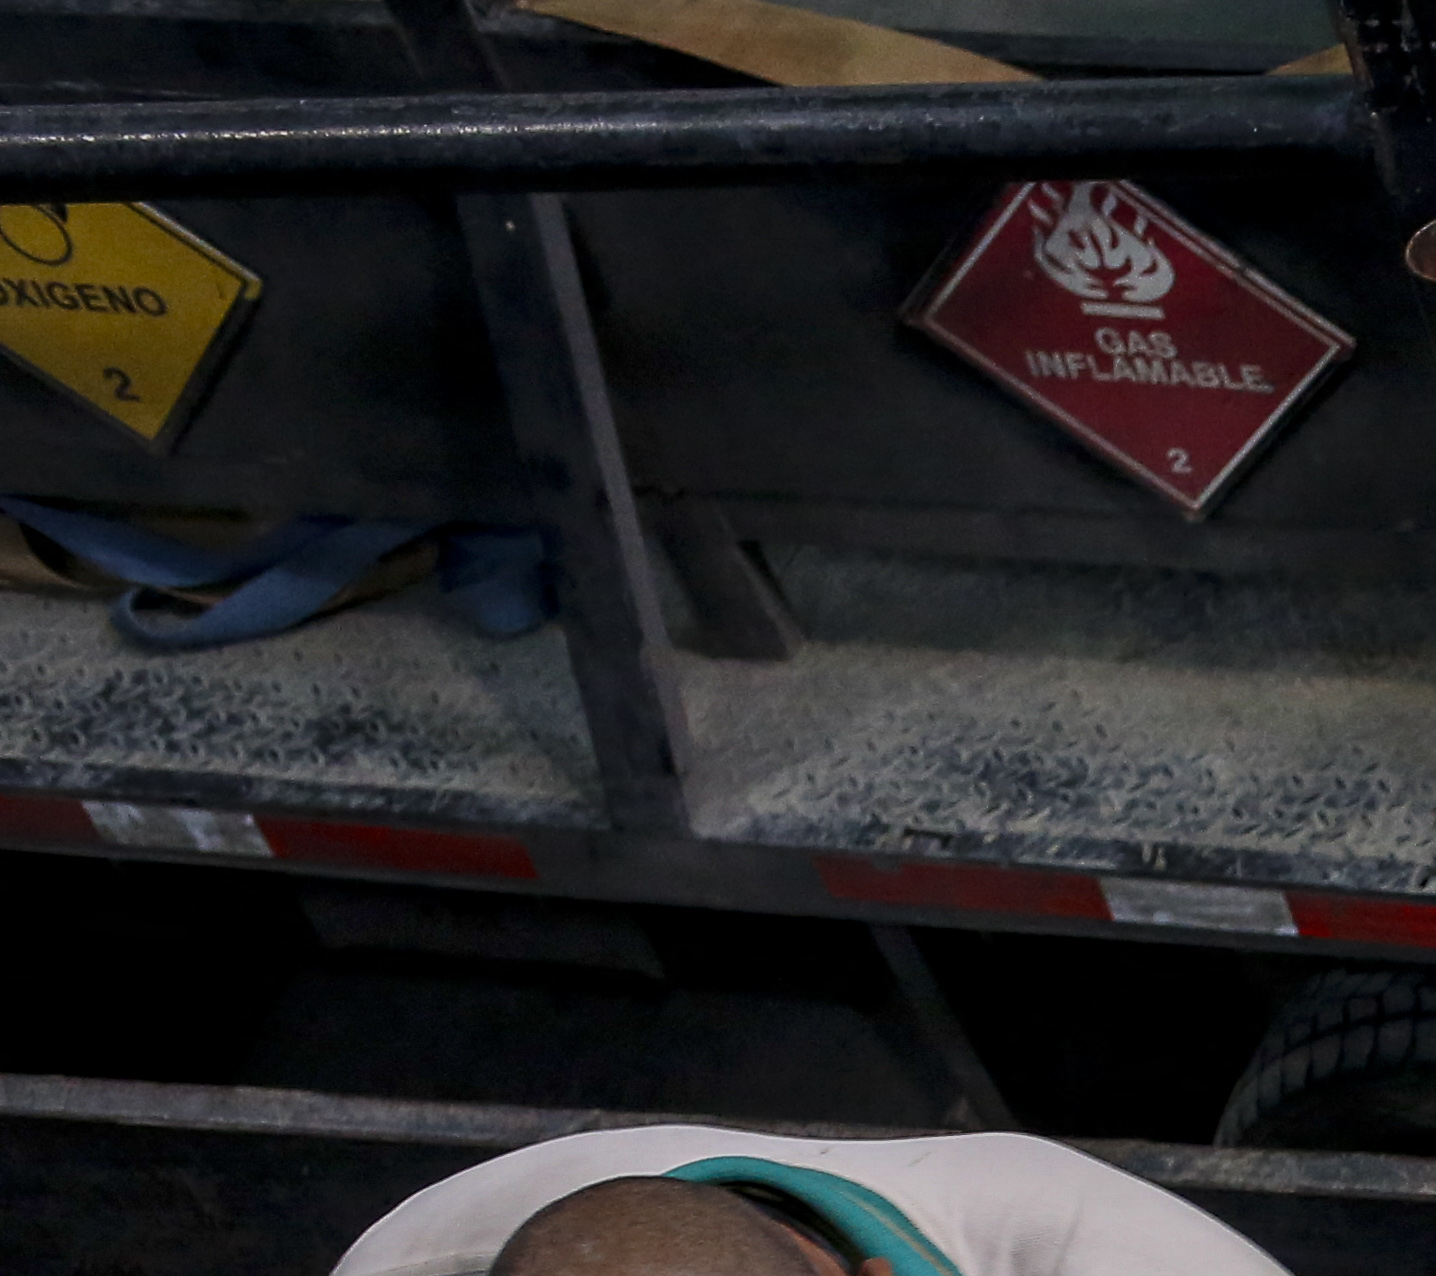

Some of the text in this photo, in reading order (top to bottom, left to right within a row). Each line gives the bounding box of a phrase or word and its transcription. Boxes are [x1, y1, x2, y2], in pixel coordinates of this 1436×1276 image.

[1093, 327, 1178, 359] GAS
[103, 367, 140, 402] 2
[1024, 350, 1275, 393] INFLAMABLE
[1165, 448, 1194, 475] 2
